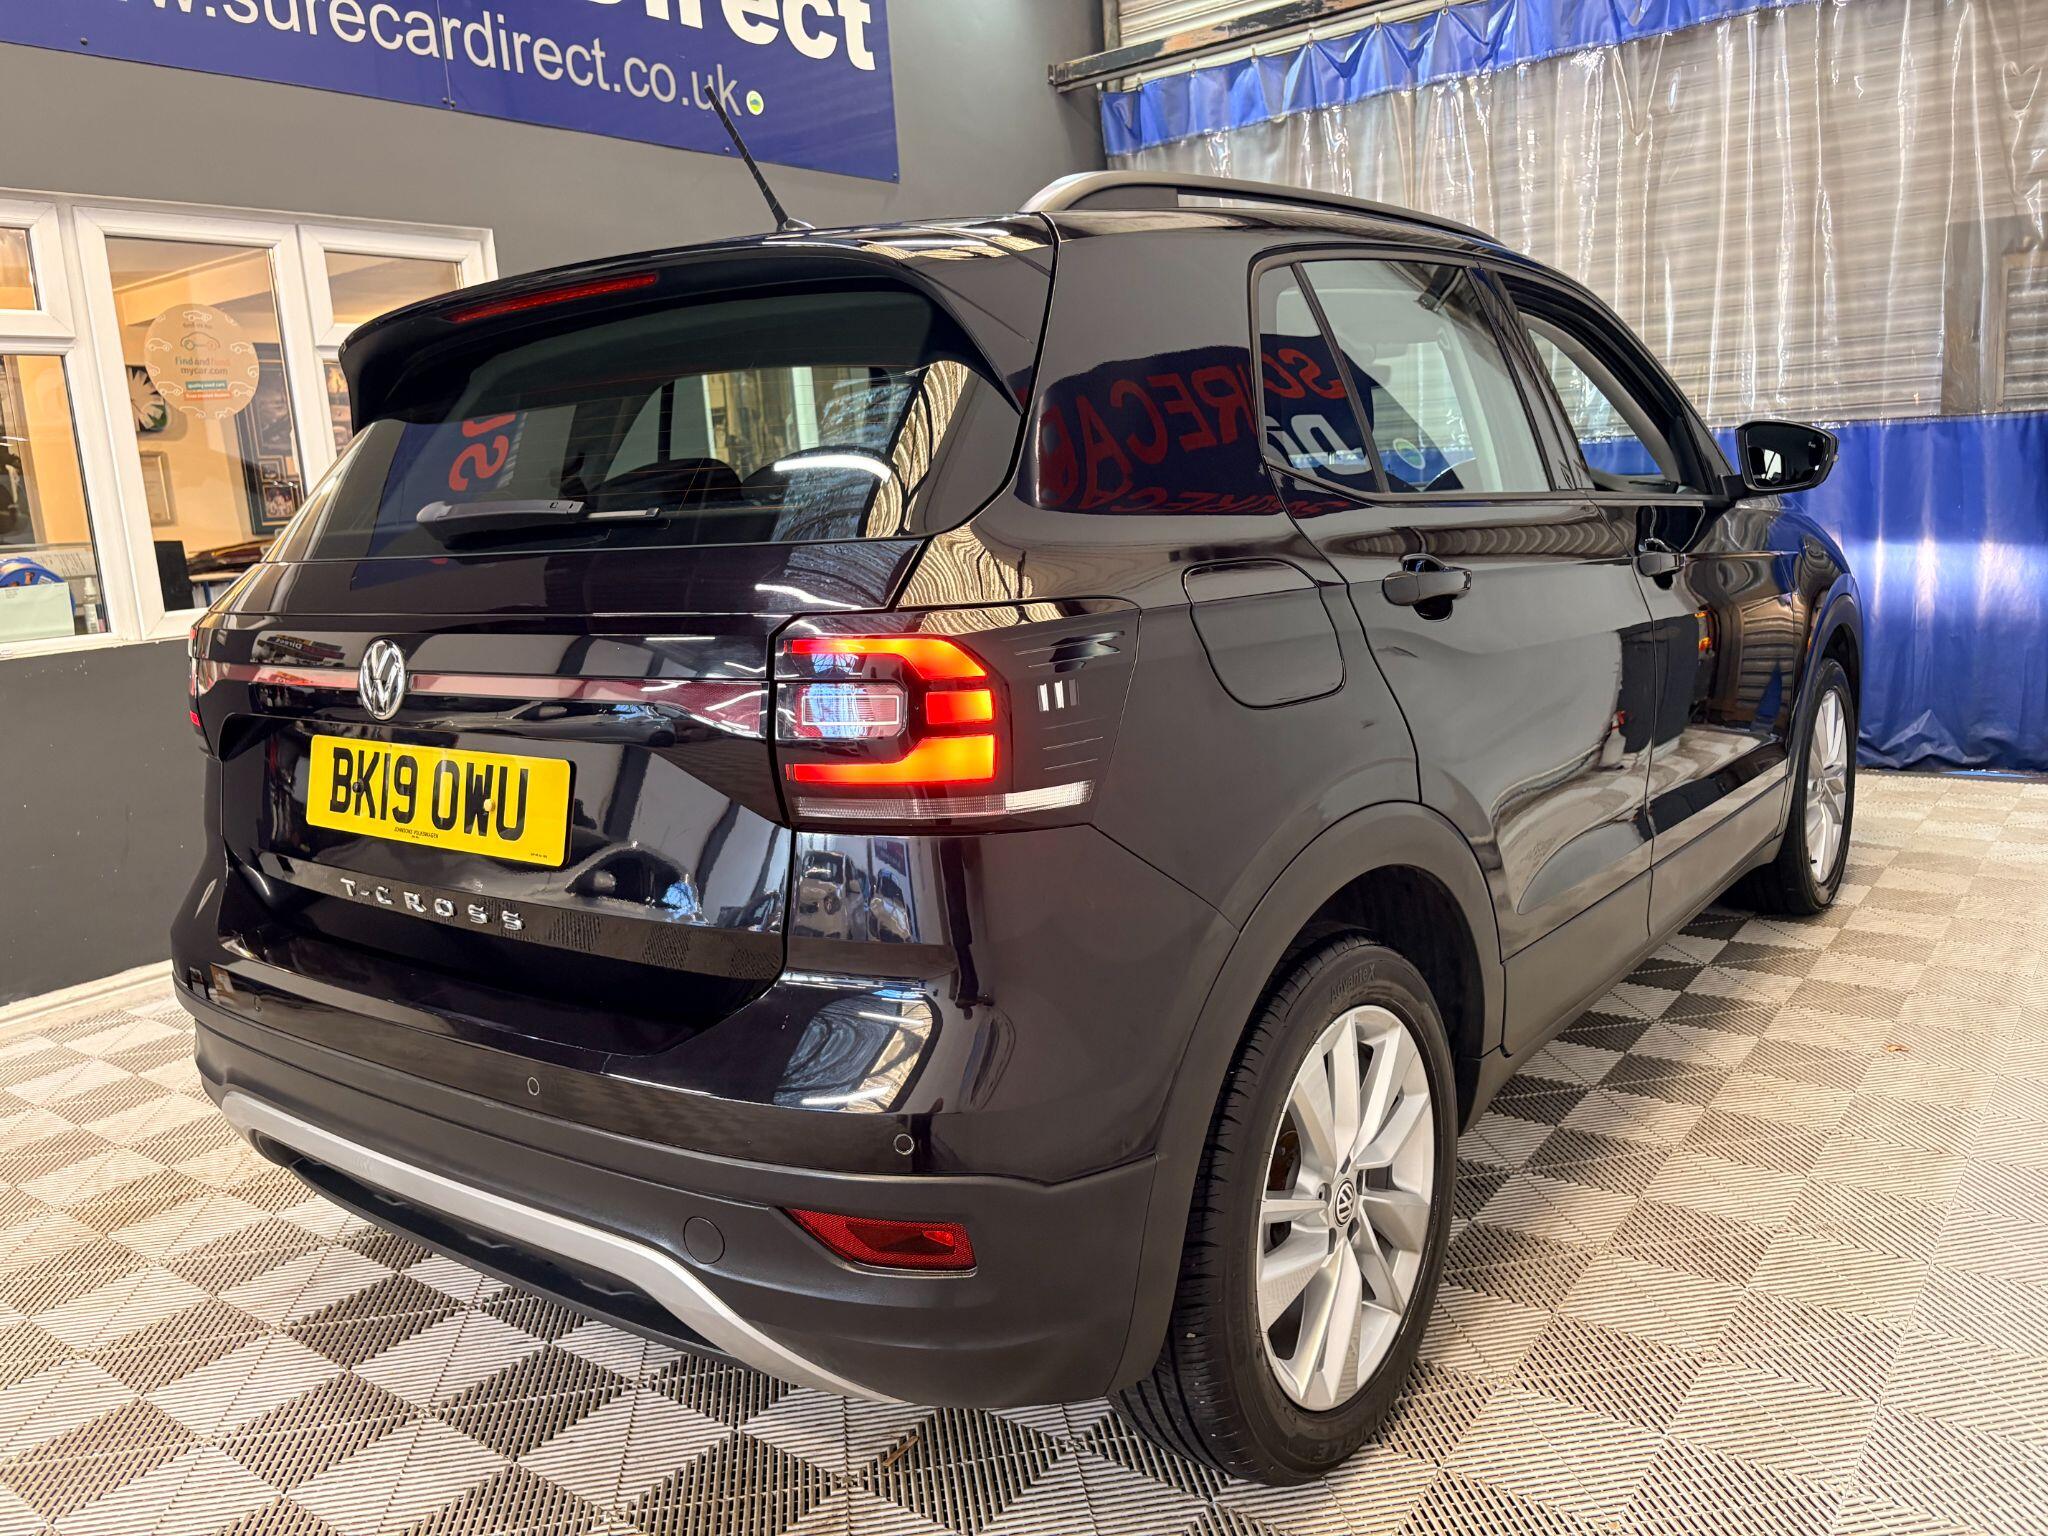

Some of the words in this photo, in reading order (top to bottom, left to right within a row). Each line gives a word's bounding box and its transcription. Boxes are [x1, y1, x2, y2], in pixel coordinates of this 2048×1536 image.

[118, 0, 742, 116] .surecardirect.co.uk
[590, 0, 876, 70] ect
[329, 746, 419, 825] BK19
[431, 759, 530, 842] OWU
[339, 877, 525, 931] T-CROSS
